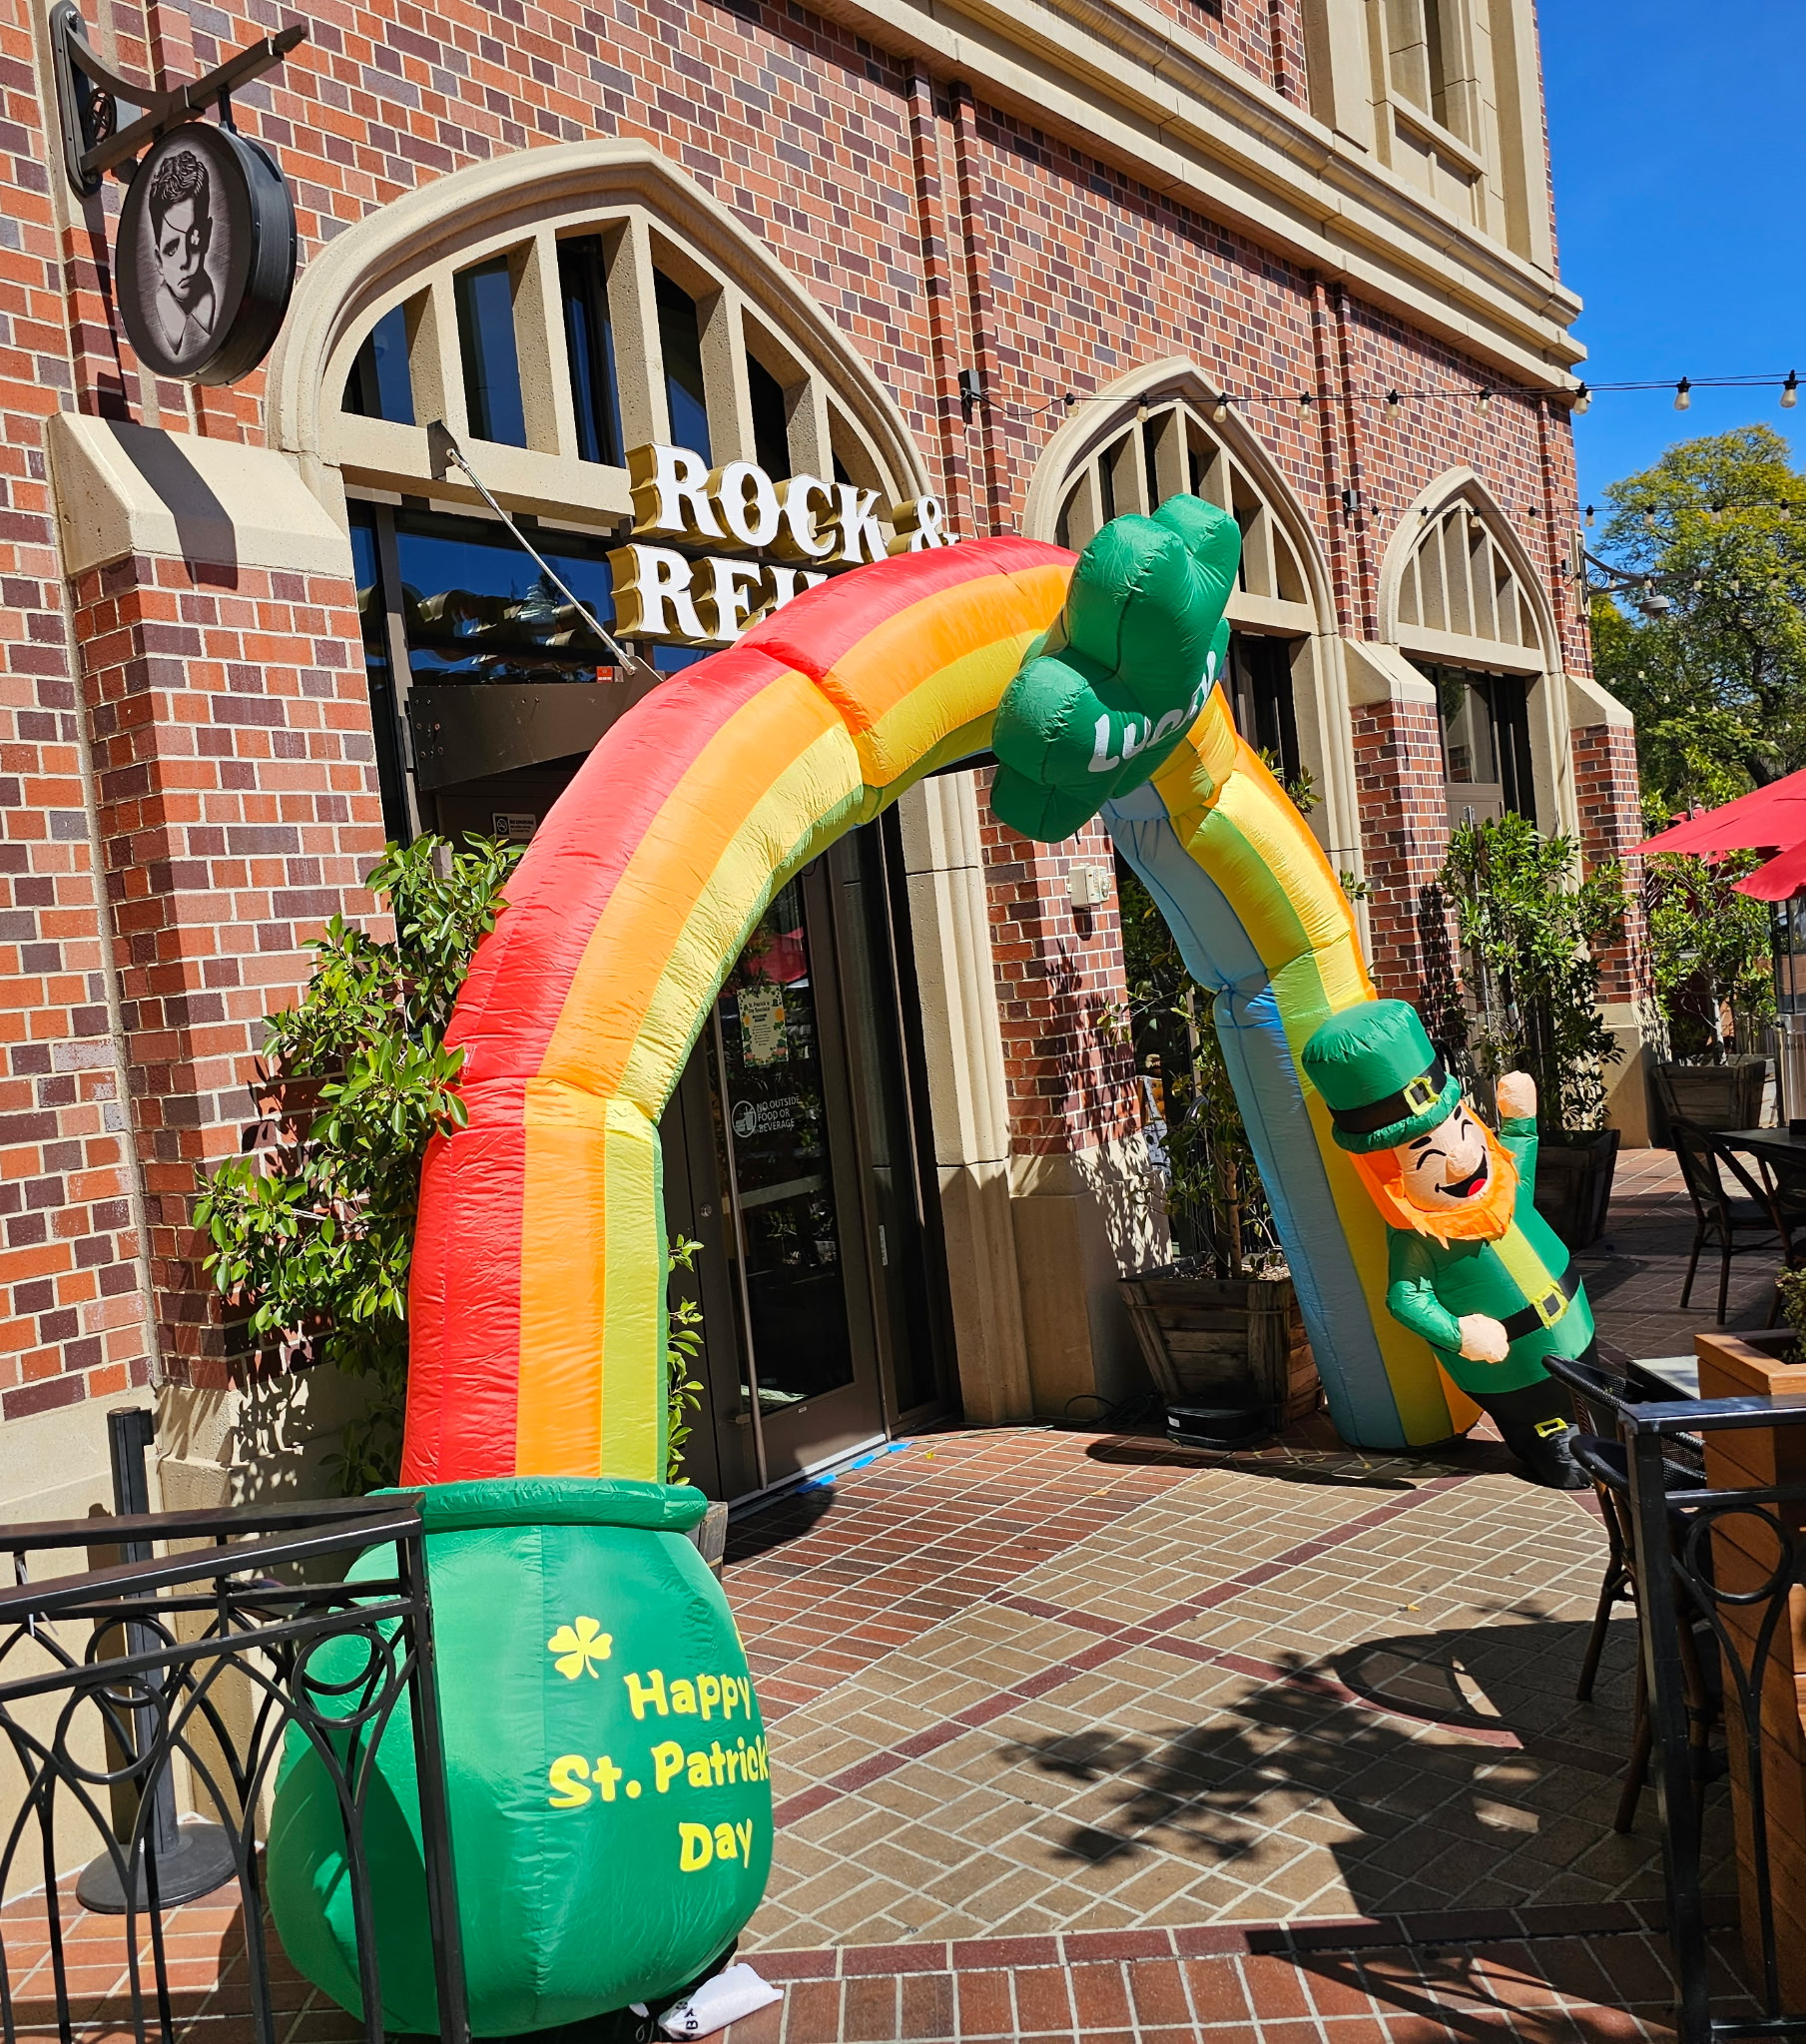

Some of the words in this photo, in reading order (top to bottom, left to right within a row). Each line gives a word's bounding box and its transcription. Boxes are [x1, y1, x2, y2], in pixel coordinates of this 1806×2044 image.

[650, 442, 889, 564] ROCK
[757, 1101, 769, 1113] NO
[769, 1095, 801, 1108] OUTSIDE
[758, 1110, 779, 1122] FOOD
[779, 1108, 791, 1118] OR
[759, 1118, 796, 1132] BEVERAGE
[623, 1669, 751, 1720] Happy
[548, 1754, 642, 1808] St.
[678, 1817, 754, 1872] Day
